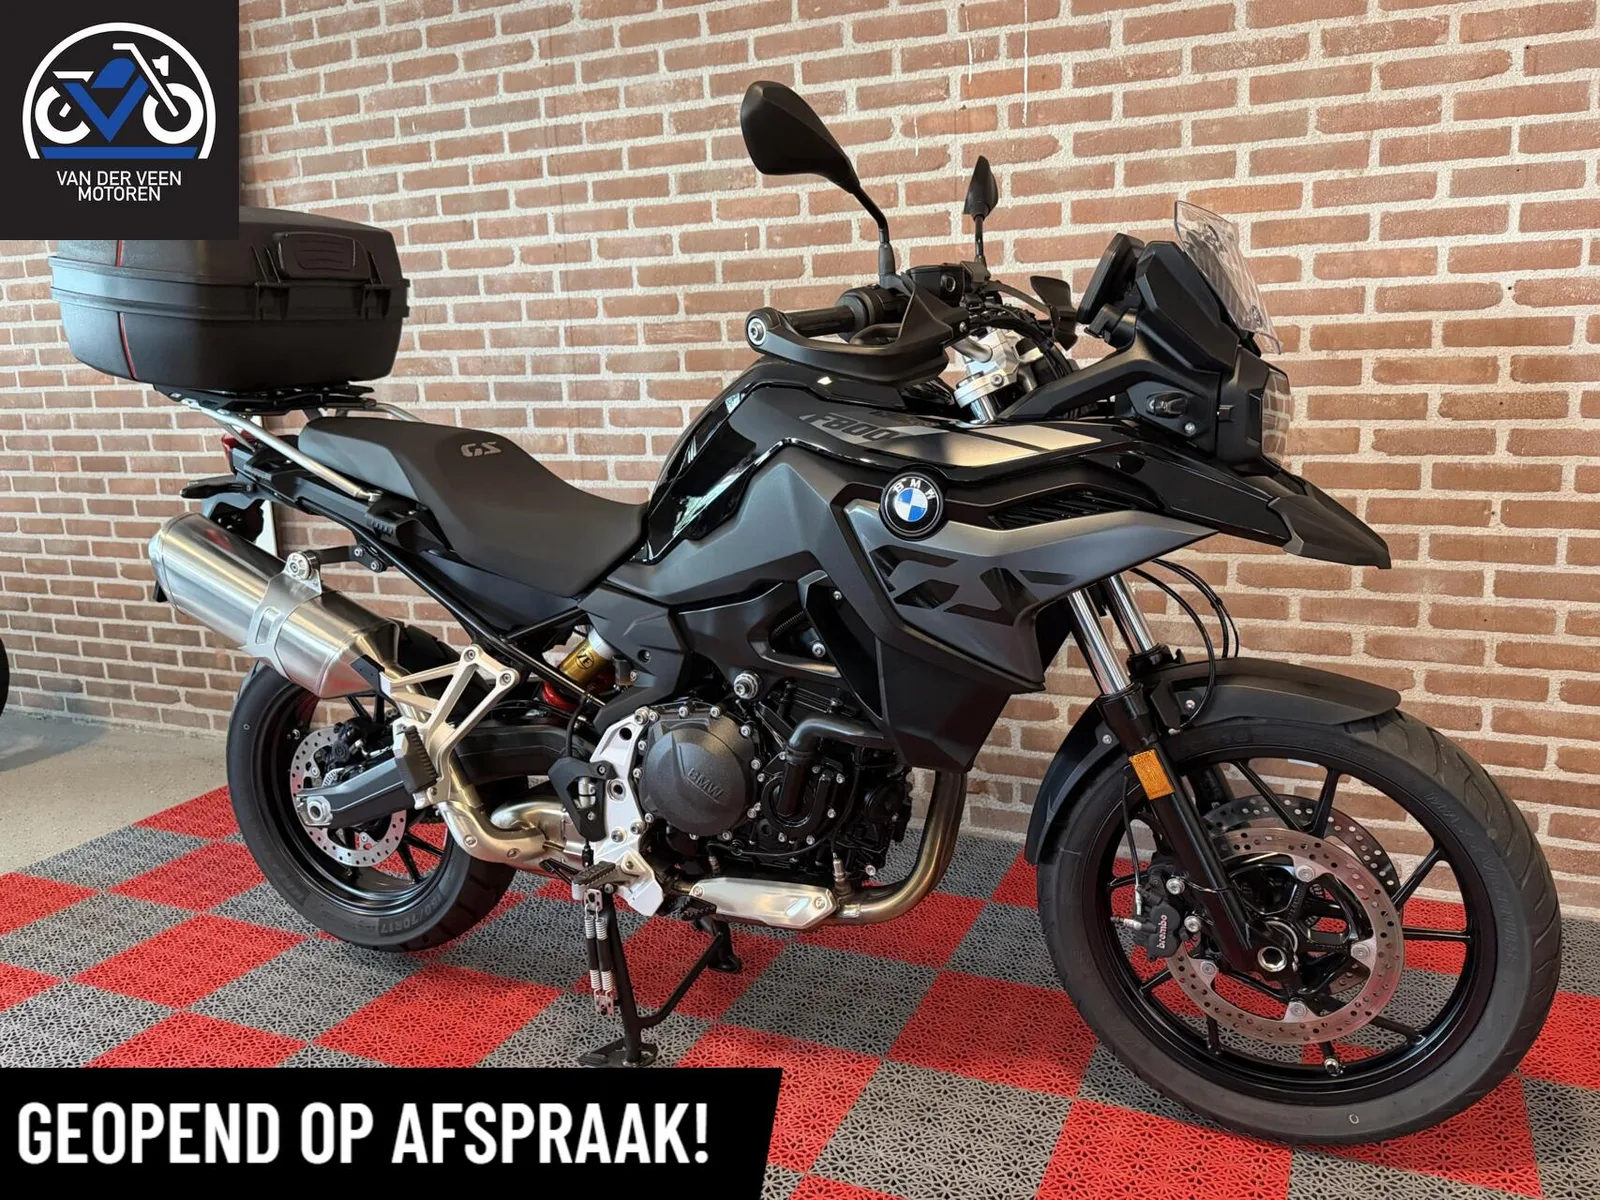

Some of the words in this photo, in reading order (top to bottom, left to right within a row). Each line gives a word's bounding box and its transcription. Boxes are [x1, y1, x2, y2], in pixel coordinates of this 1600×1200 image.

[461, 441, 502, 458] GS
[893, 478, 937, 501] BMW
[687, 767, 724, 799] BMW
[1156, 914, 1168, 949] brembo
